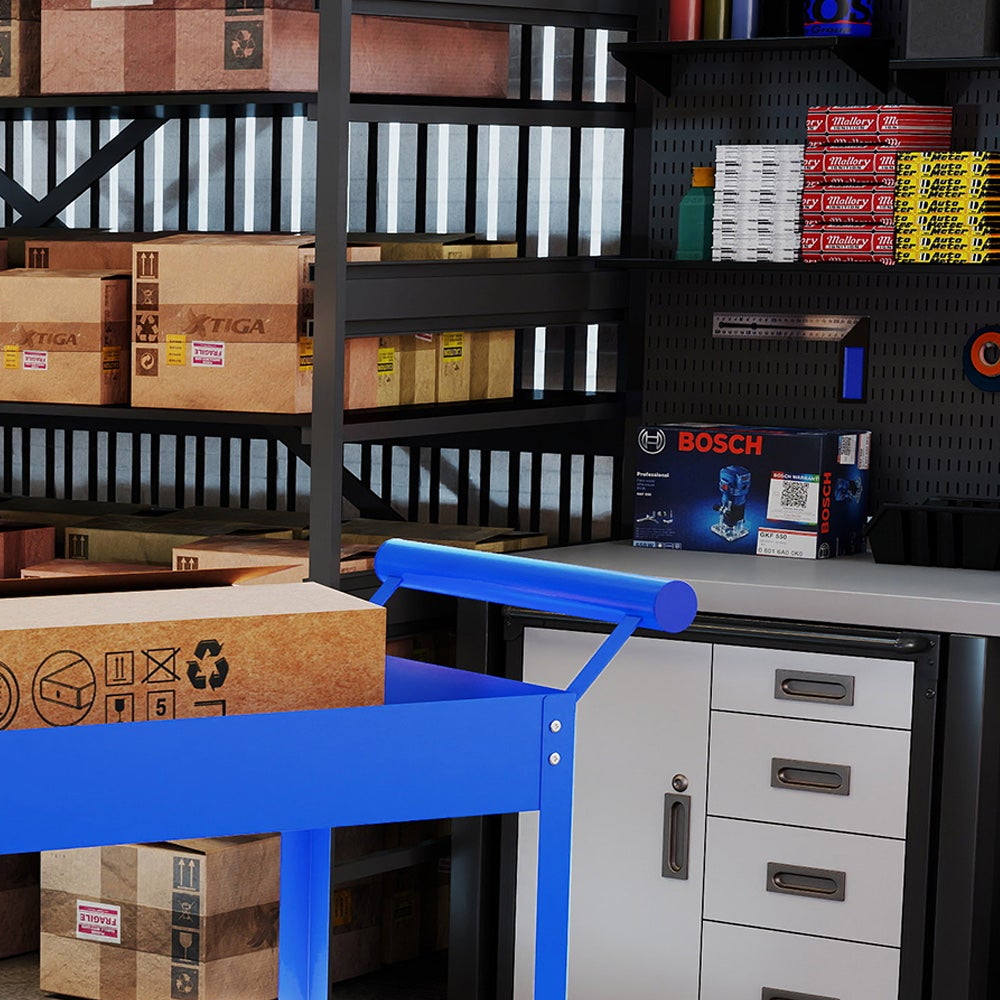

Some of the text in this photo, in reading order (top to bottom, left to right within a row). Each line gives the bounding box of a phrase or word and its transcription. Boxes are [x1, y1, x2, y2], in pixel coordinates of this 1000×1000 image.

[832, 116, 874, 126] Mallory
[829, 156, 871, 166] Mallory
[828, 196, 869, 206] Mallory
[928, 206, 965, 214] Meter
[827, 236, 869, 245] Mallory
[678, 432, 763, 456] BOSCH
[821, 472, 832, 534] BOSCH
[155, 698, 166, 716] 5
[80, 912, 117, 927] FRAGILE
